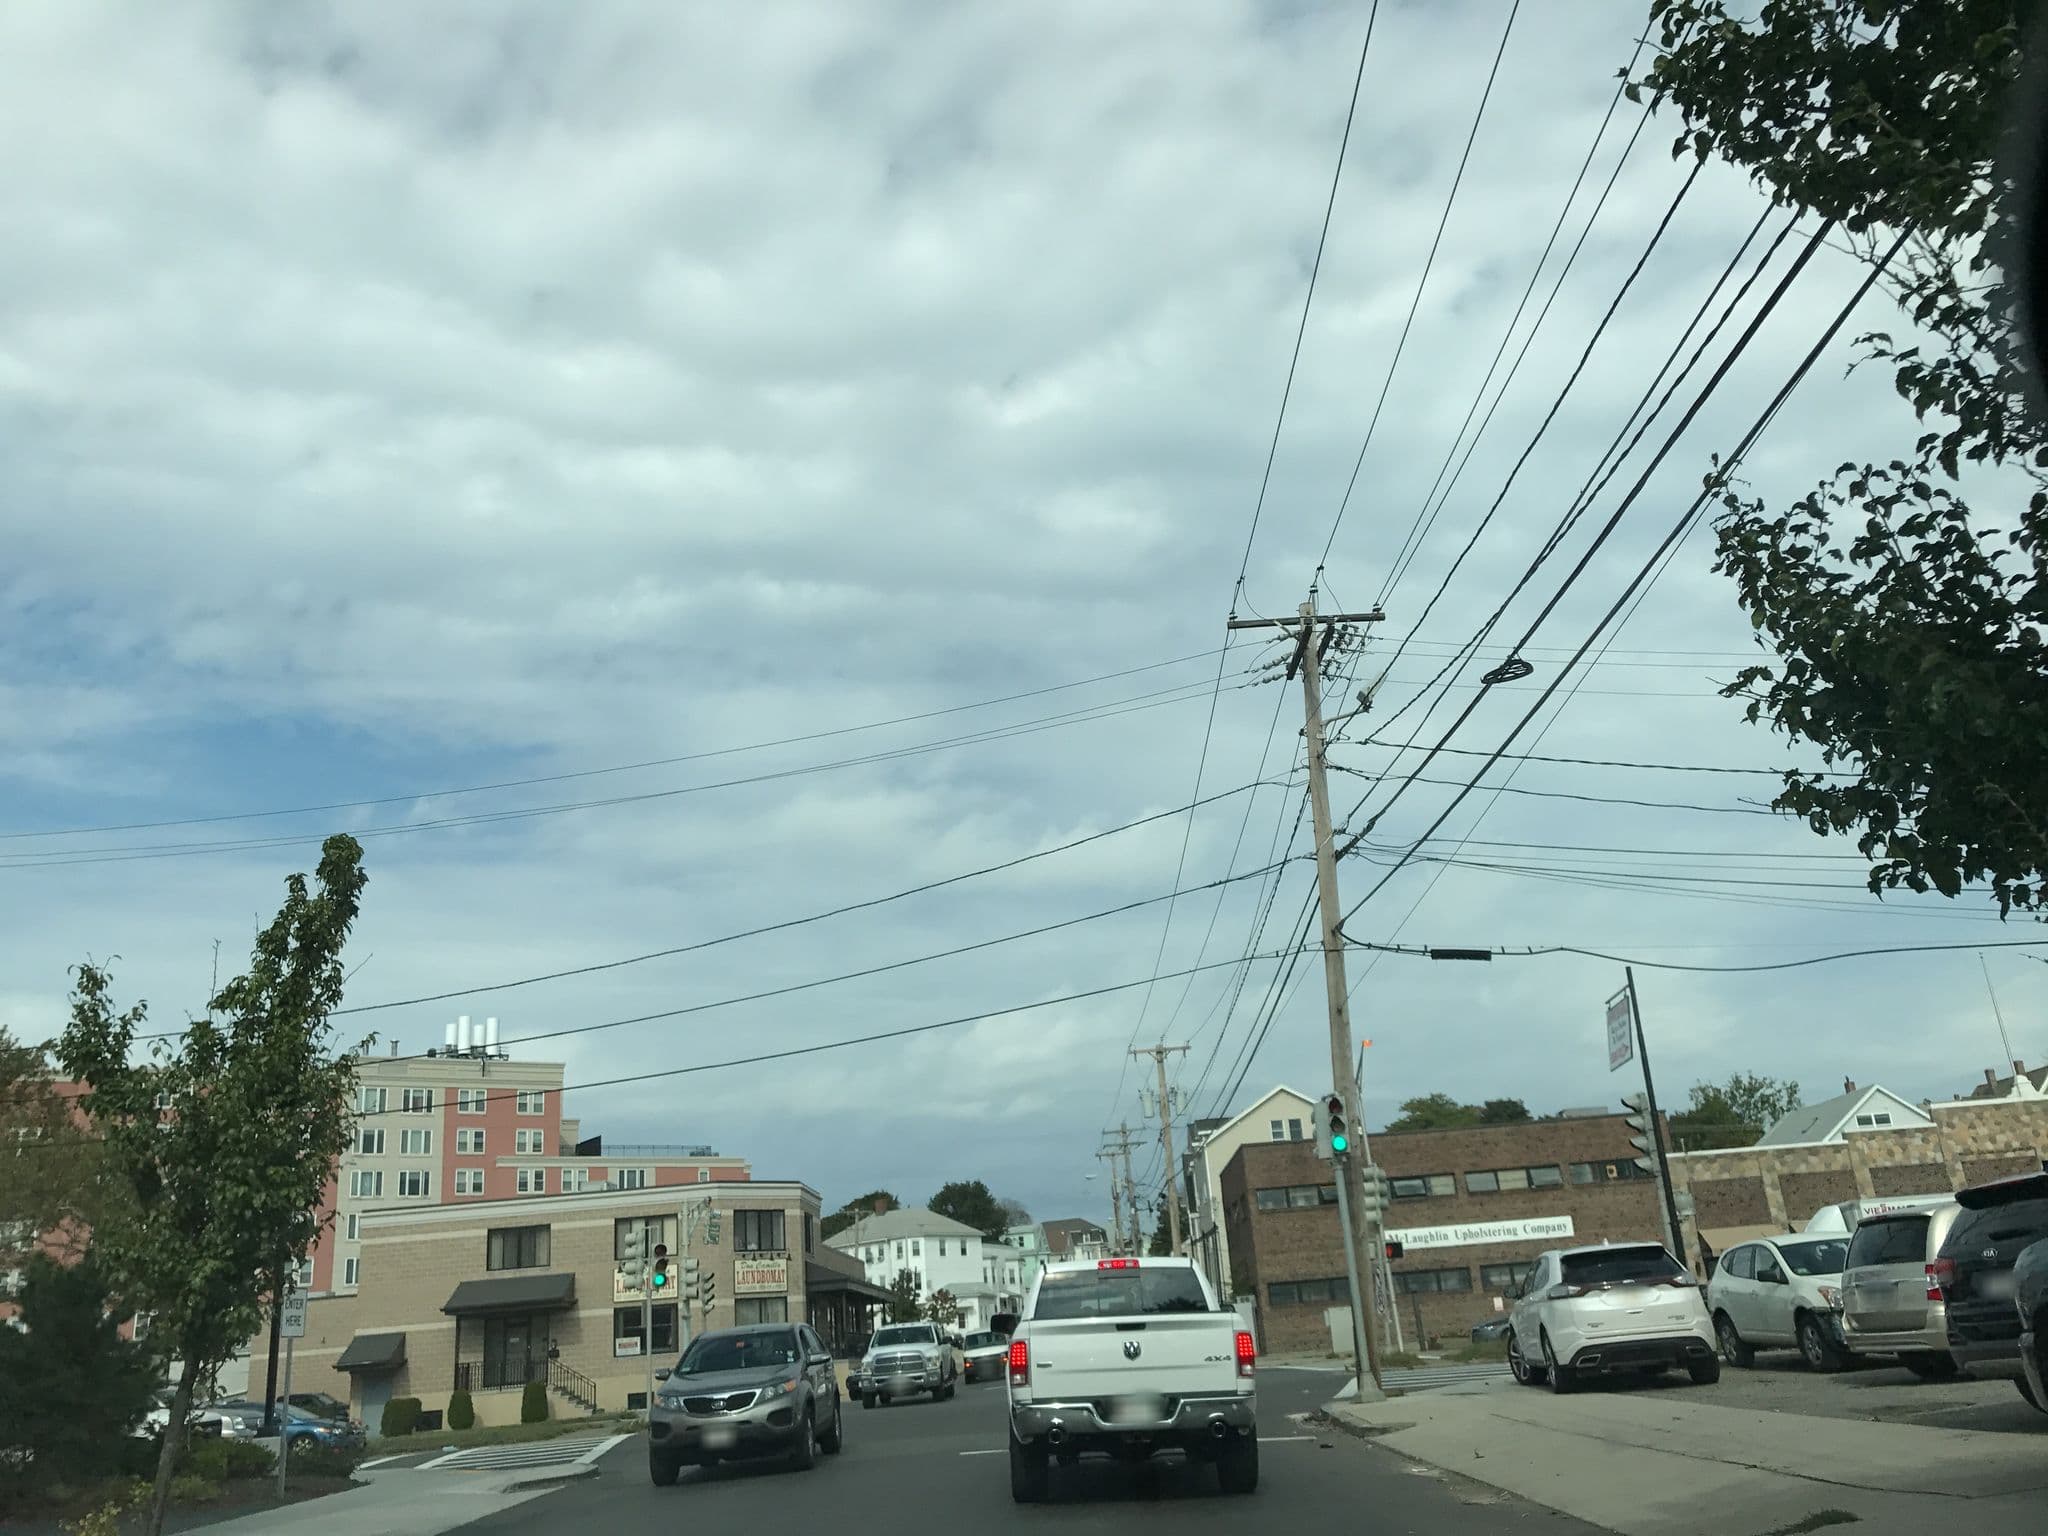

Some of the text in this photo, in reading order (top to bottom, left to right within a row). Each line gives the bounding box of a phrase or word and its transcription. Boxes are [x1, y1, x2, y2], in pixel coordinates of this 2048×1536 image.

[1388, 1222, 1567, 1244] McLaughlin Upholstering Company
[284, 1298, 304, 1310] ENTER
[285, 1315, 302, 1326] HERE
